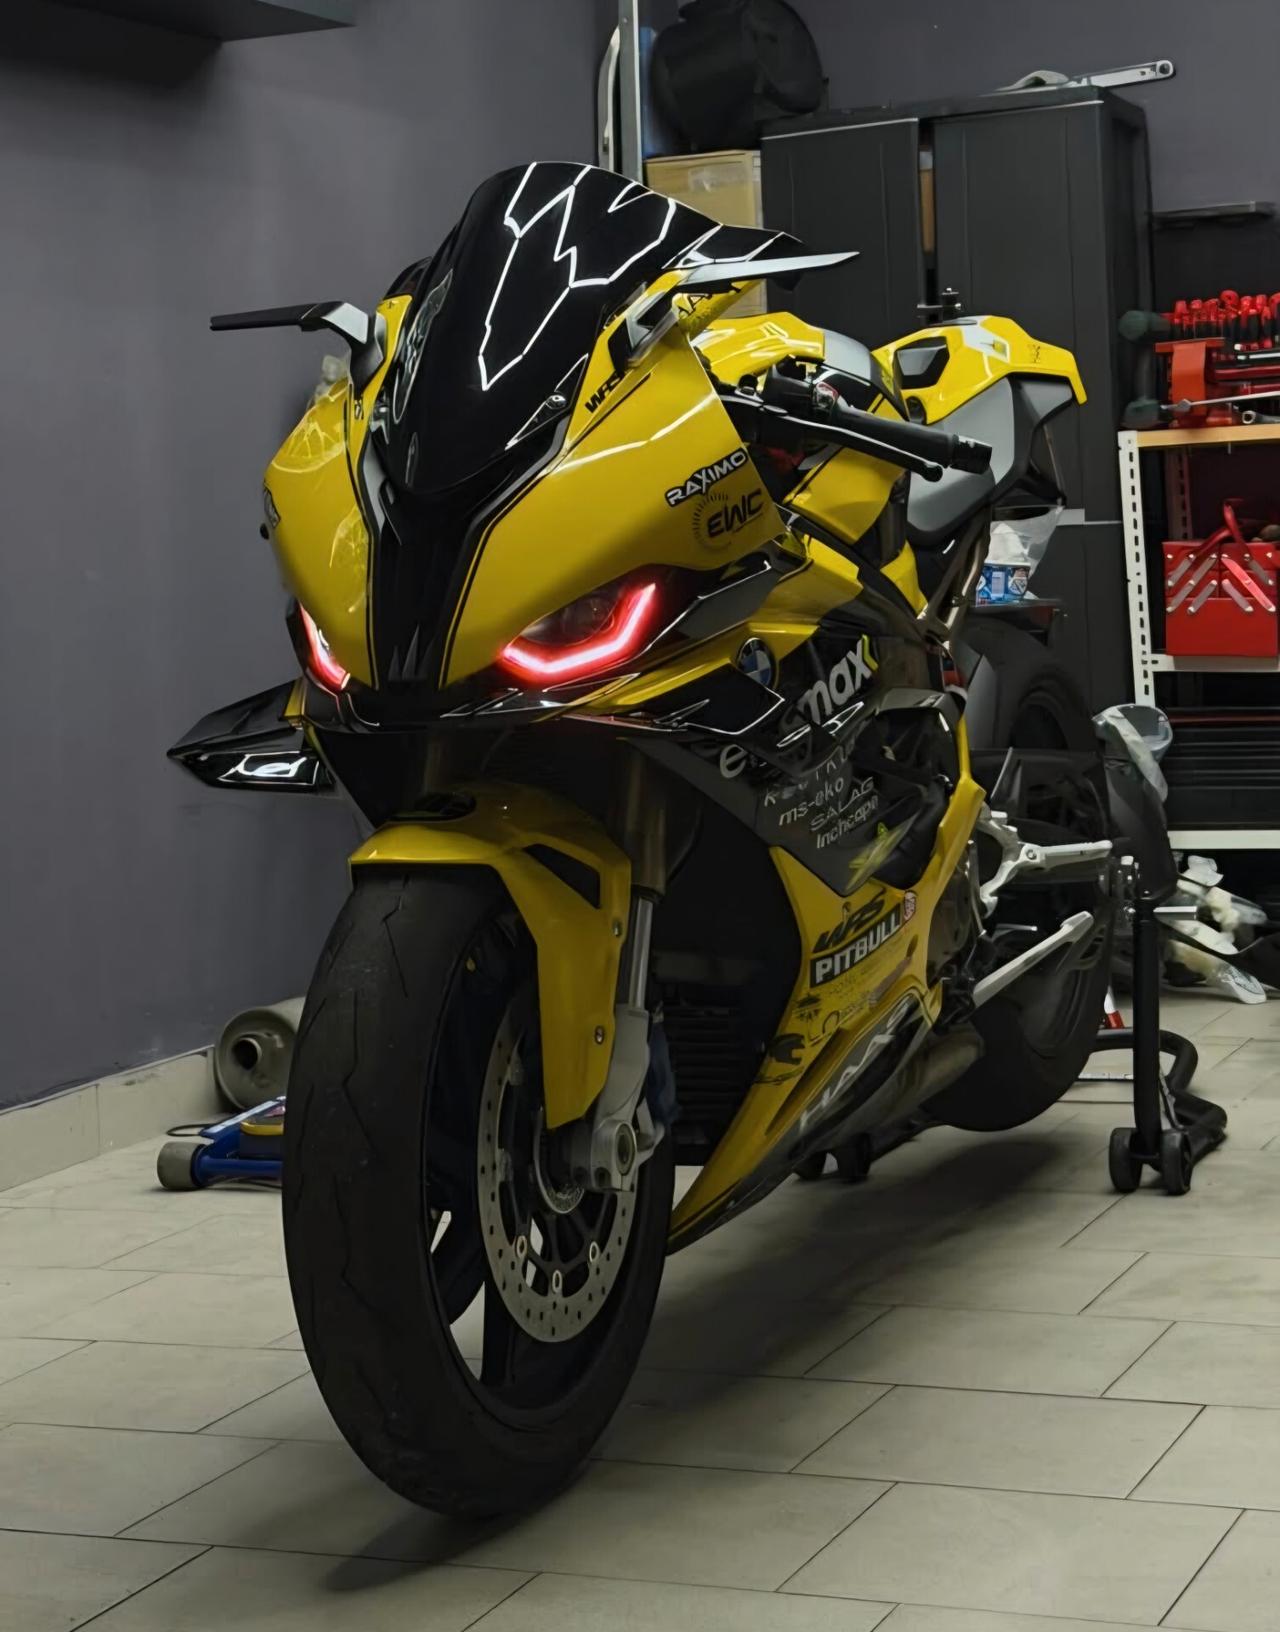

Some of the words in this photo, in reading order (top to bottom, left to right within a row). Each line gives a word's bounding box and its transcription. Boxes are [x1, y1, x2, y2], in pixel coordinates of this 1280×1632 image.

[667, 451, 746, 506] RAXIMO
[707, 488, 762, 538] EWC
[816, 911, 900, 984] PITBULL
